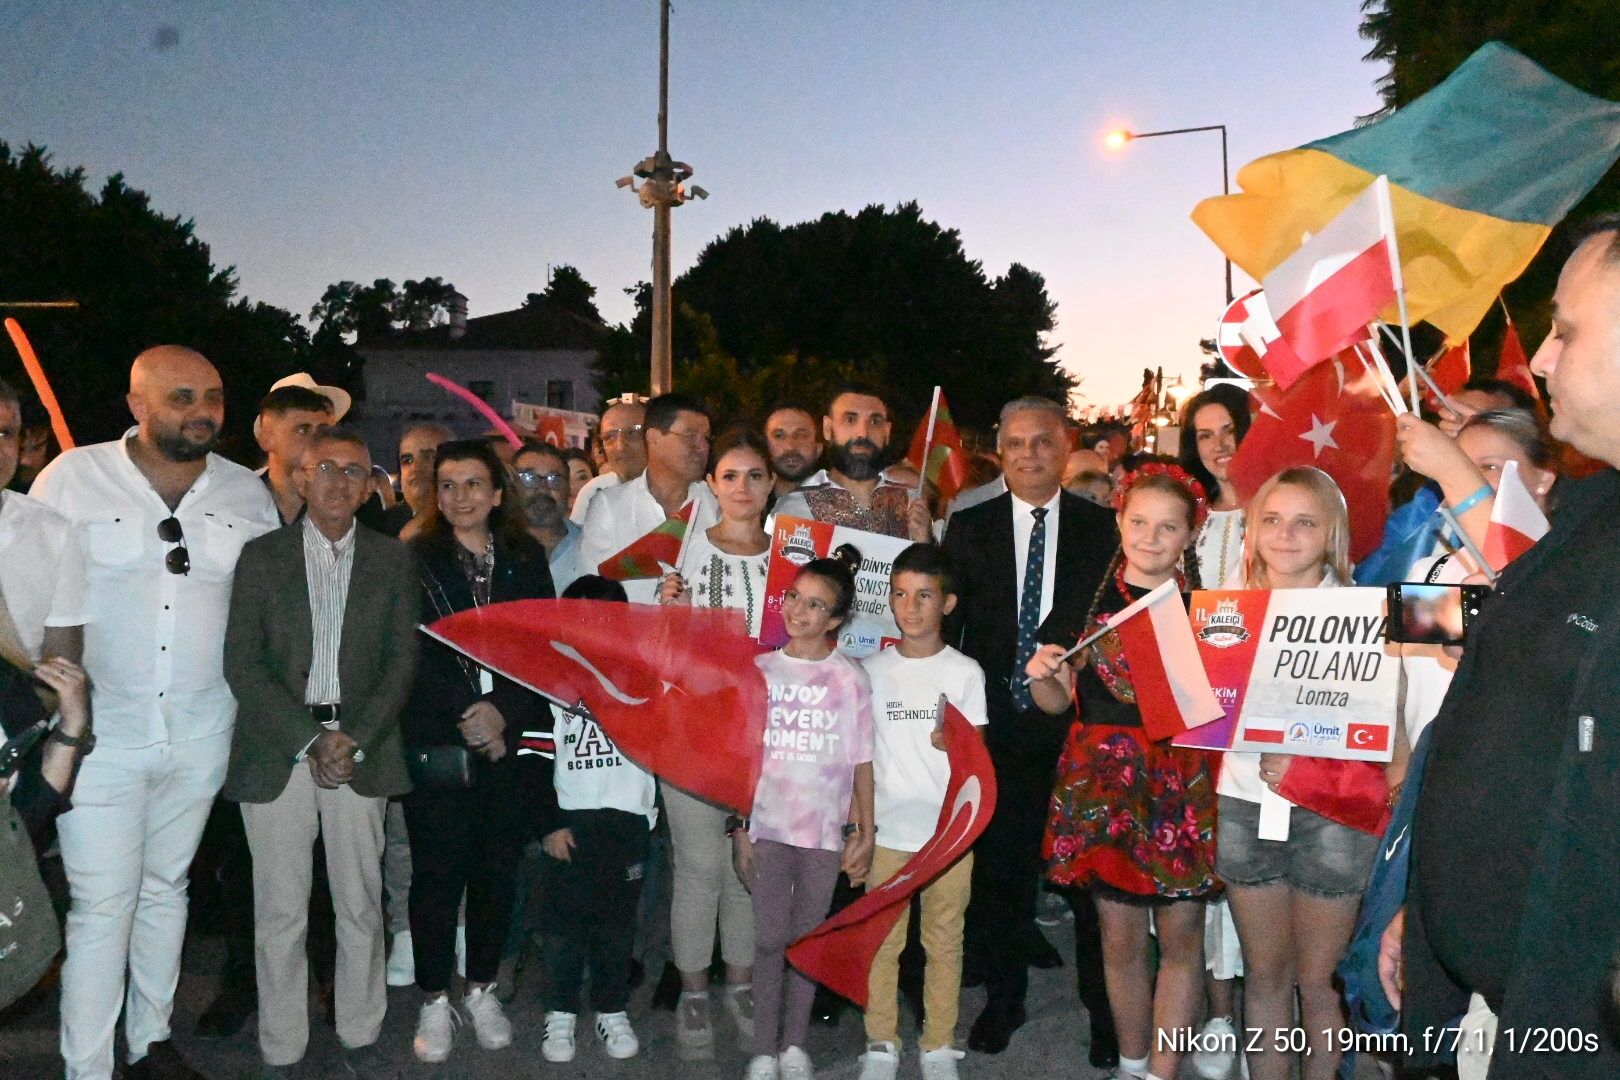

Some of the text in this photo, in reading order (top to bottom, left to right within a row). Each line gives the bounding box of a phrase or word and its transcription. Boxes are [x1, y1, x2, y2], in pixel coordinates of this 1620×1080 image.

[860, 557, 892, 575] DİNYE
[1269, 615, 1390, 645] POLONYA
[1273, 649, 1382, 682] POLAND
[1296, 685, 1350, 707] Lomza
[771, 707, 839, 731] EVERY
[567, 756, 622, 771] SCHOOL
